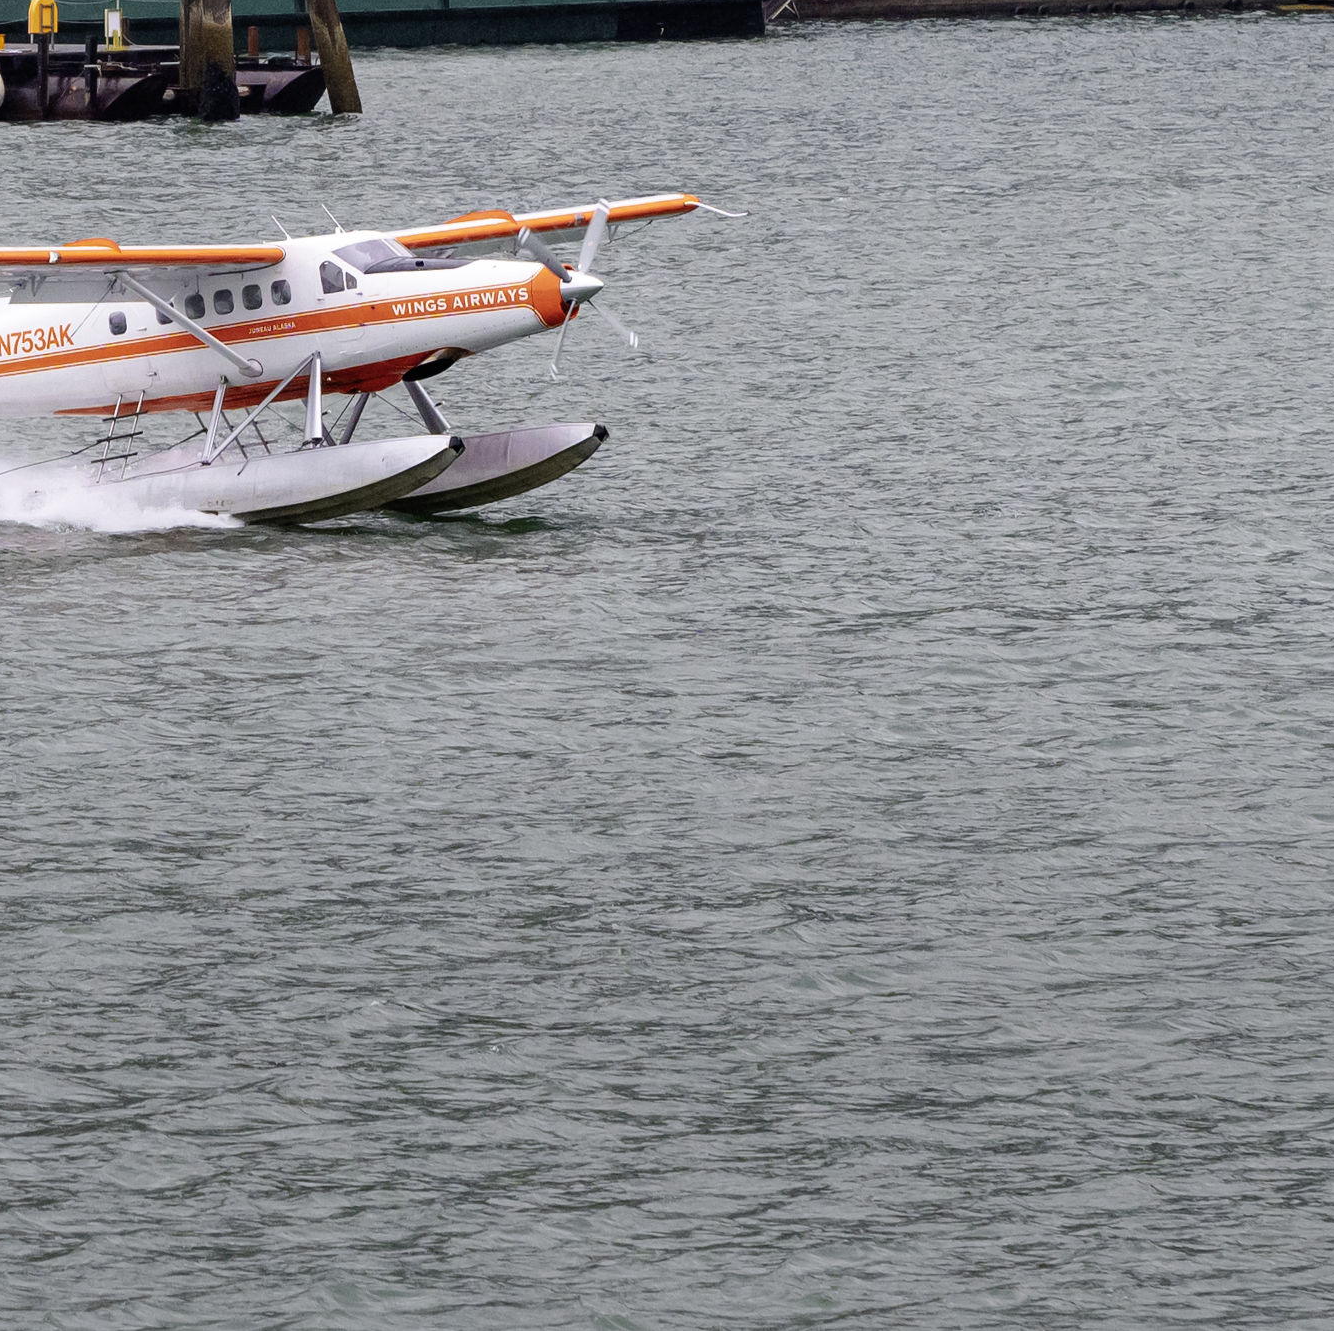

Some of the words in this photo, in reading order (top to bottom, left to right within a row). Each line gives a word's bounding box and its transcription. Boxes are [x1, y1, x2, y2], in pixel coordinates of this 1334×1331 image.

[392, 298, 447, 316] WINGS
[453, 287, 529, 309] AIRWAYS
[272, 321, 297, 331] ALASKA
